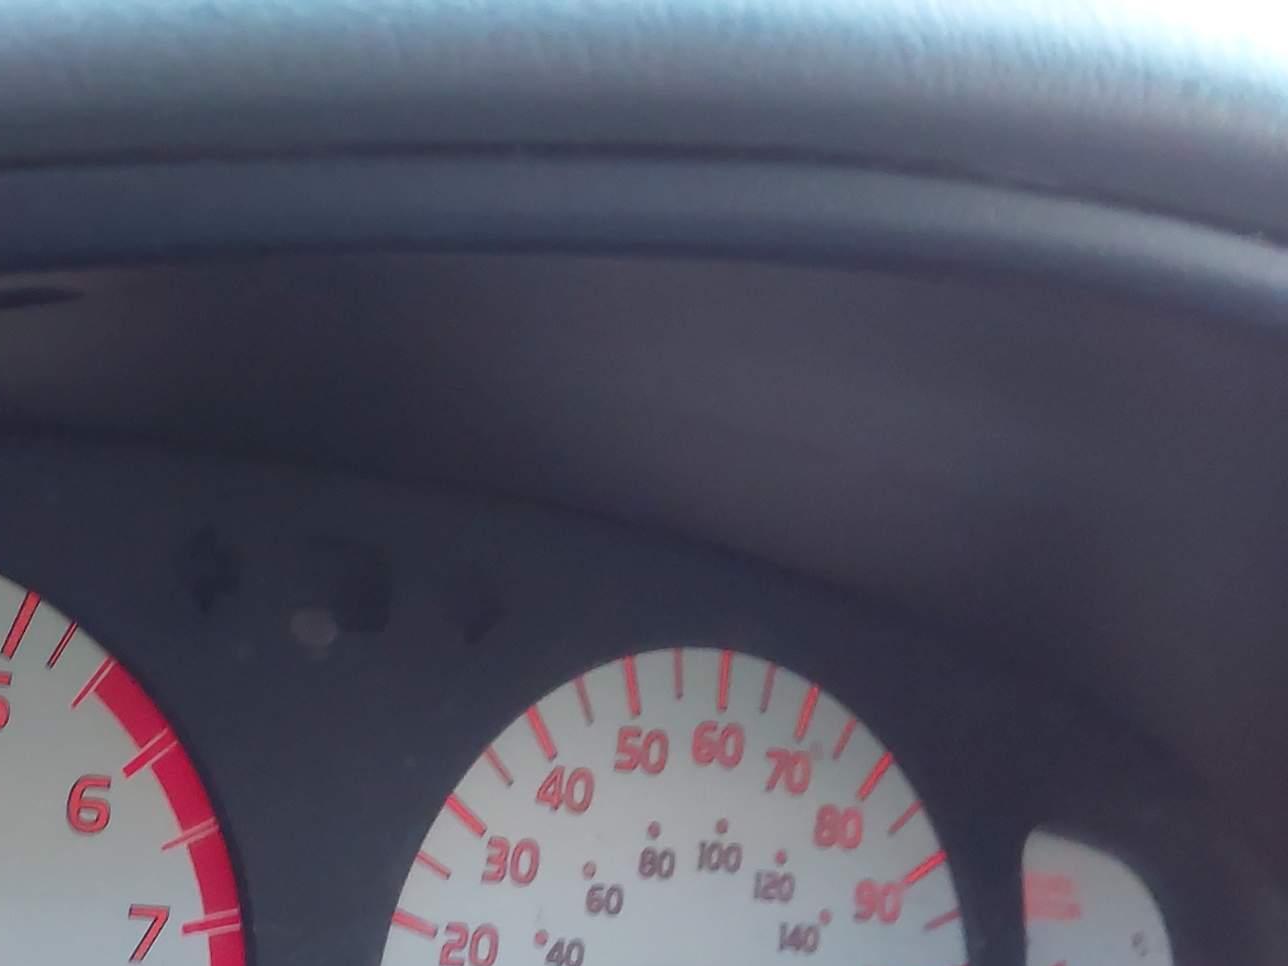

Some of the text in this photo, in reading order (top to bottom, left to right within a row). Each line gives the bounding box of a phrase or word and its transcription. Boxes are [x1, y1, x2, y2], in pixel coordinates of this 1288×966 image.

[613, 726, 669, 776] 50
[691, 720, 746, 769] 60
[535, 765, 595, 815] 40
[765, 748, 813, 795] 70
[65, 774, 113, 835] 6
[812, 803, 863, 850] 80
[481, 835, 540, 886] 30
[637, 846, 675, 879] 80
[696, 841, 743, 873] 100
[584, 884, 625, 916] 60
[753, 870, 795, 903] 120
[854, 879, 902, 925] 90
[127, 903, 171, 964] 7
[777, 921, 820, 954] 140
